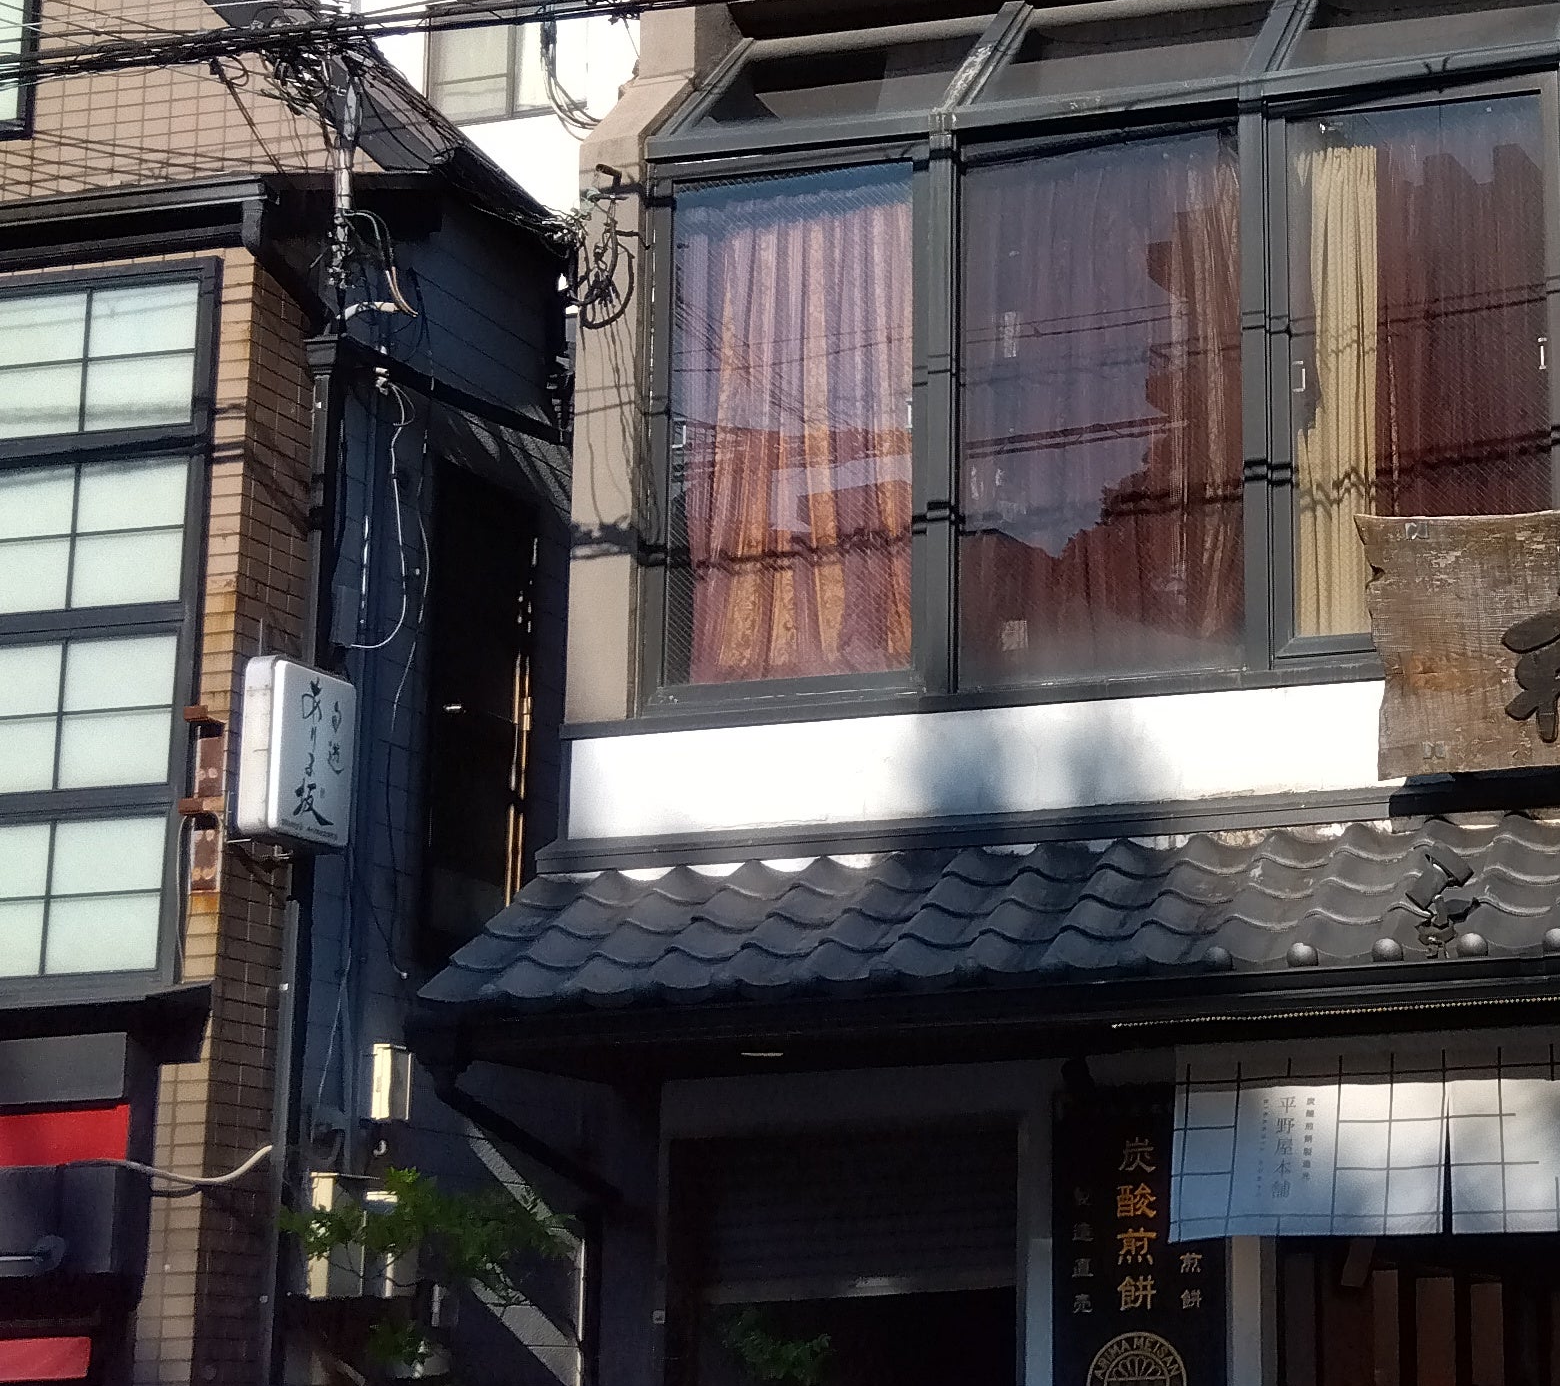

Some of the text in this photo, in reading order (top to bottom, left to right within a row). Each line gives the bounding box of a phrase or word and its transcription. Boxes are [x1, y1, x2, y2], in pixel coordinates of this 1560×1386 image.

[1271, 1095, 1297, 1199] 平野屋本舗
[1115, 1136, 1158, 1313] 炭酸煎餅
